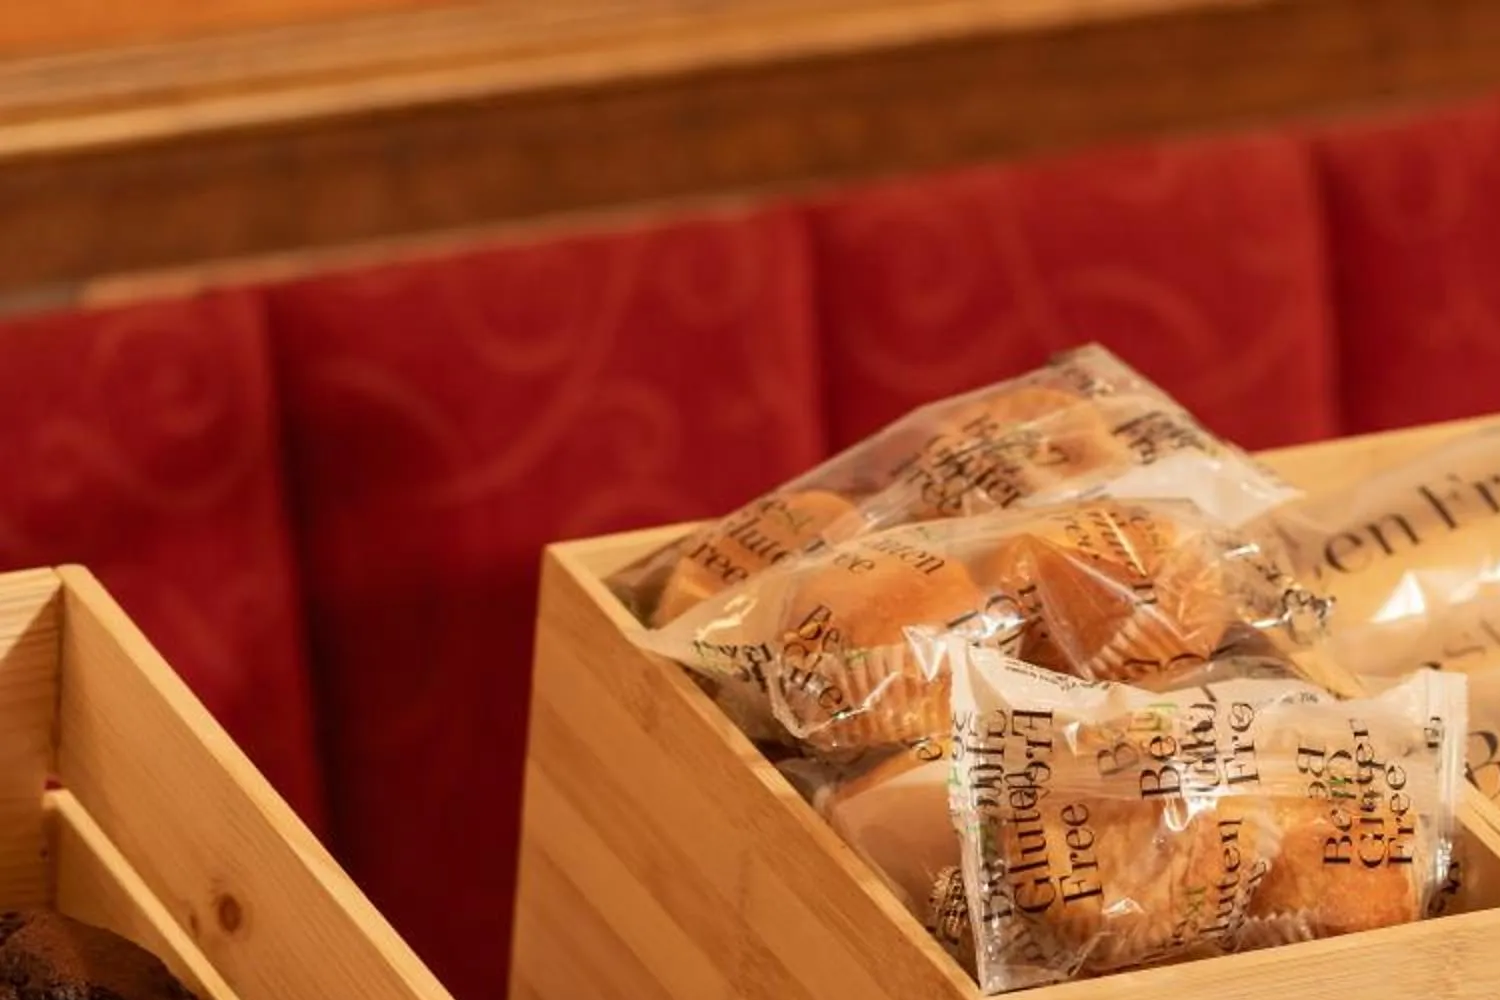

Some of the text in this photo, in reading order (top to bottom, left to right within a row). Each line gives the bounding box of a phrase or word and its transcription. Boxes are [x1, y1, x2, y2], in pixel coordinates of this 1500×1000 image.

[1060, 802, 1106, 908] Free
[1386, 758, 1416, 865] Free
[1199, 818, 1244, 938] luten
